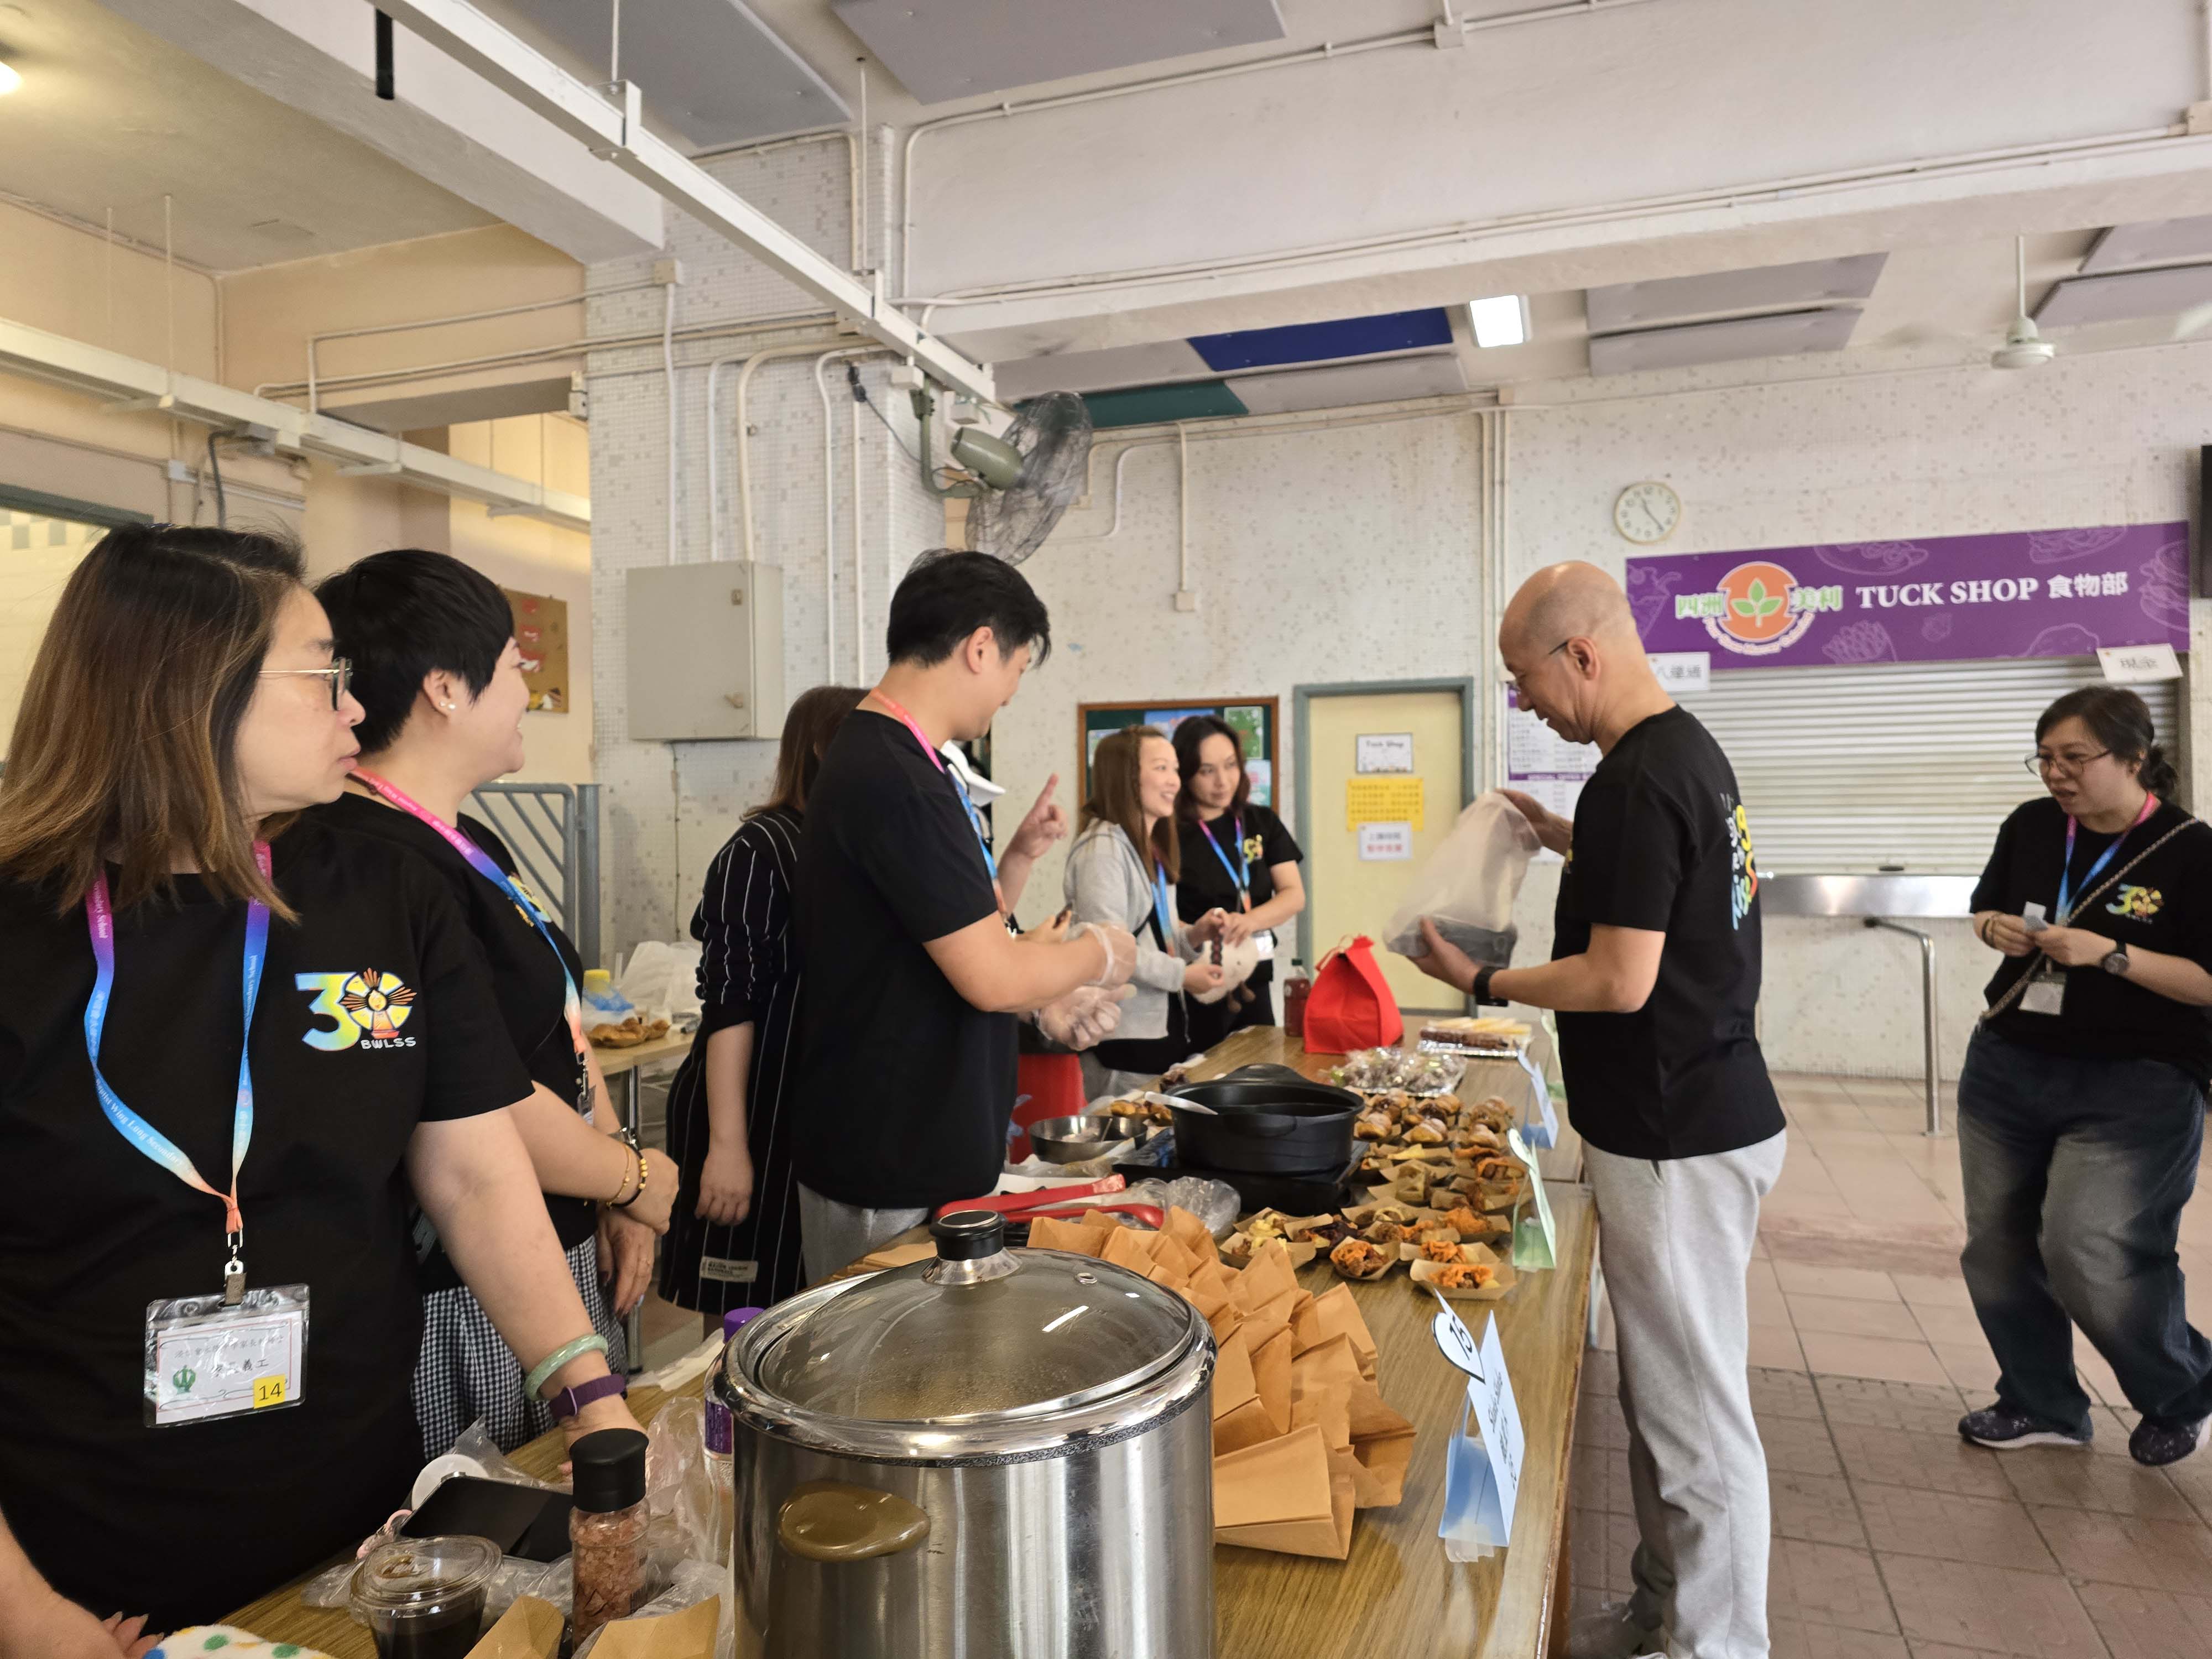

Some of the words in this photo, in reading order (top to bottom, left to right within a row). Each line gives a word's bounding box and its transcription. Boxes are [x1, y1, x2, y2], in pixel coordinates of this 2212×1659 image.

[1855, 582, 1944, 608] TUCK
[1950, 577, 2039, 604] SHOP
[2047, 571, 2128, 599] 食物部
[360, 1036, 416, 1050] BWLSS
[258, 1382, 283, 1401] 14
